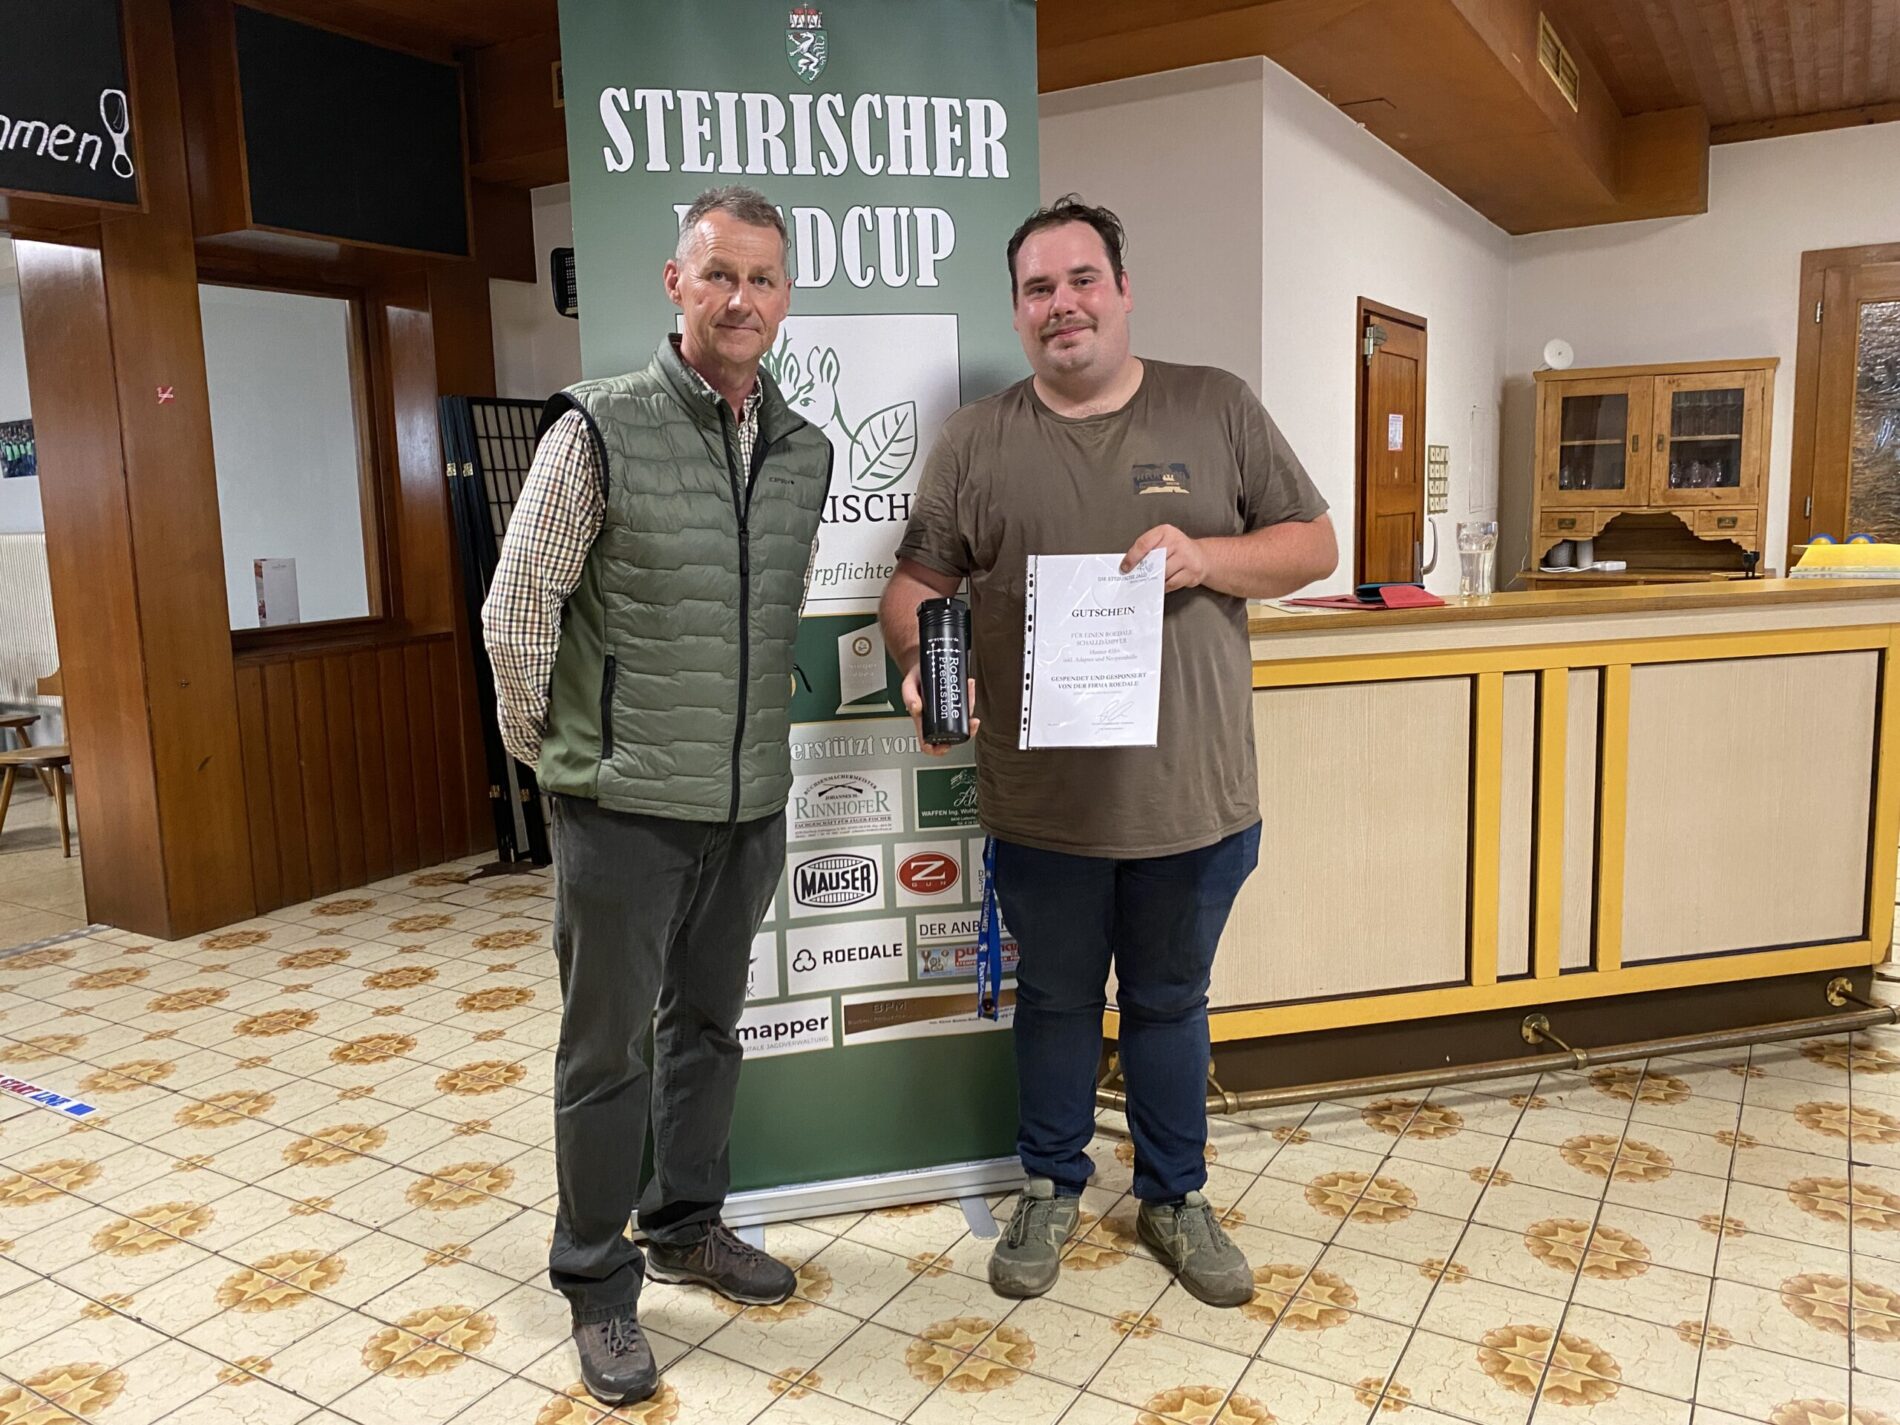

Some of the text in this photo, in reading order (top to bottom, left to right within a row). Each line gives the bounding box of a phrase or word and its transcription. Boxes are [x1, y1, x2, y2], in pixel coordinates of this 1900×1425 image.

[600, 87, 1010, 179] STEIRISCHER
[820, 493, 916, 524] ISCH
[1071, 606, 1136, 618] GUTSCHEIN
[938, 656, 949, 719] Precision
[949, 656, 962, 719] Roedale
[1051, 674, 1088, 682] GESPENDET
[1105, 672, 1147, 681] GESPONSERT
[790, 736, 875, 761] erstützt
[795, 790, 891, 820] RINNHOFER
[921, 809, 948, 817] WAFFEN
[801, 864, 871, 901] MAUSER
[911, 860, 946, 882] Z
[919, 921, 946, 937] DER
[823, 943, 903, 965] ROEDALE
[736, 1016, 829, 1041] mapper
[743, 1036, 829, 1053] ITALE JAGDVERWALTUNG
